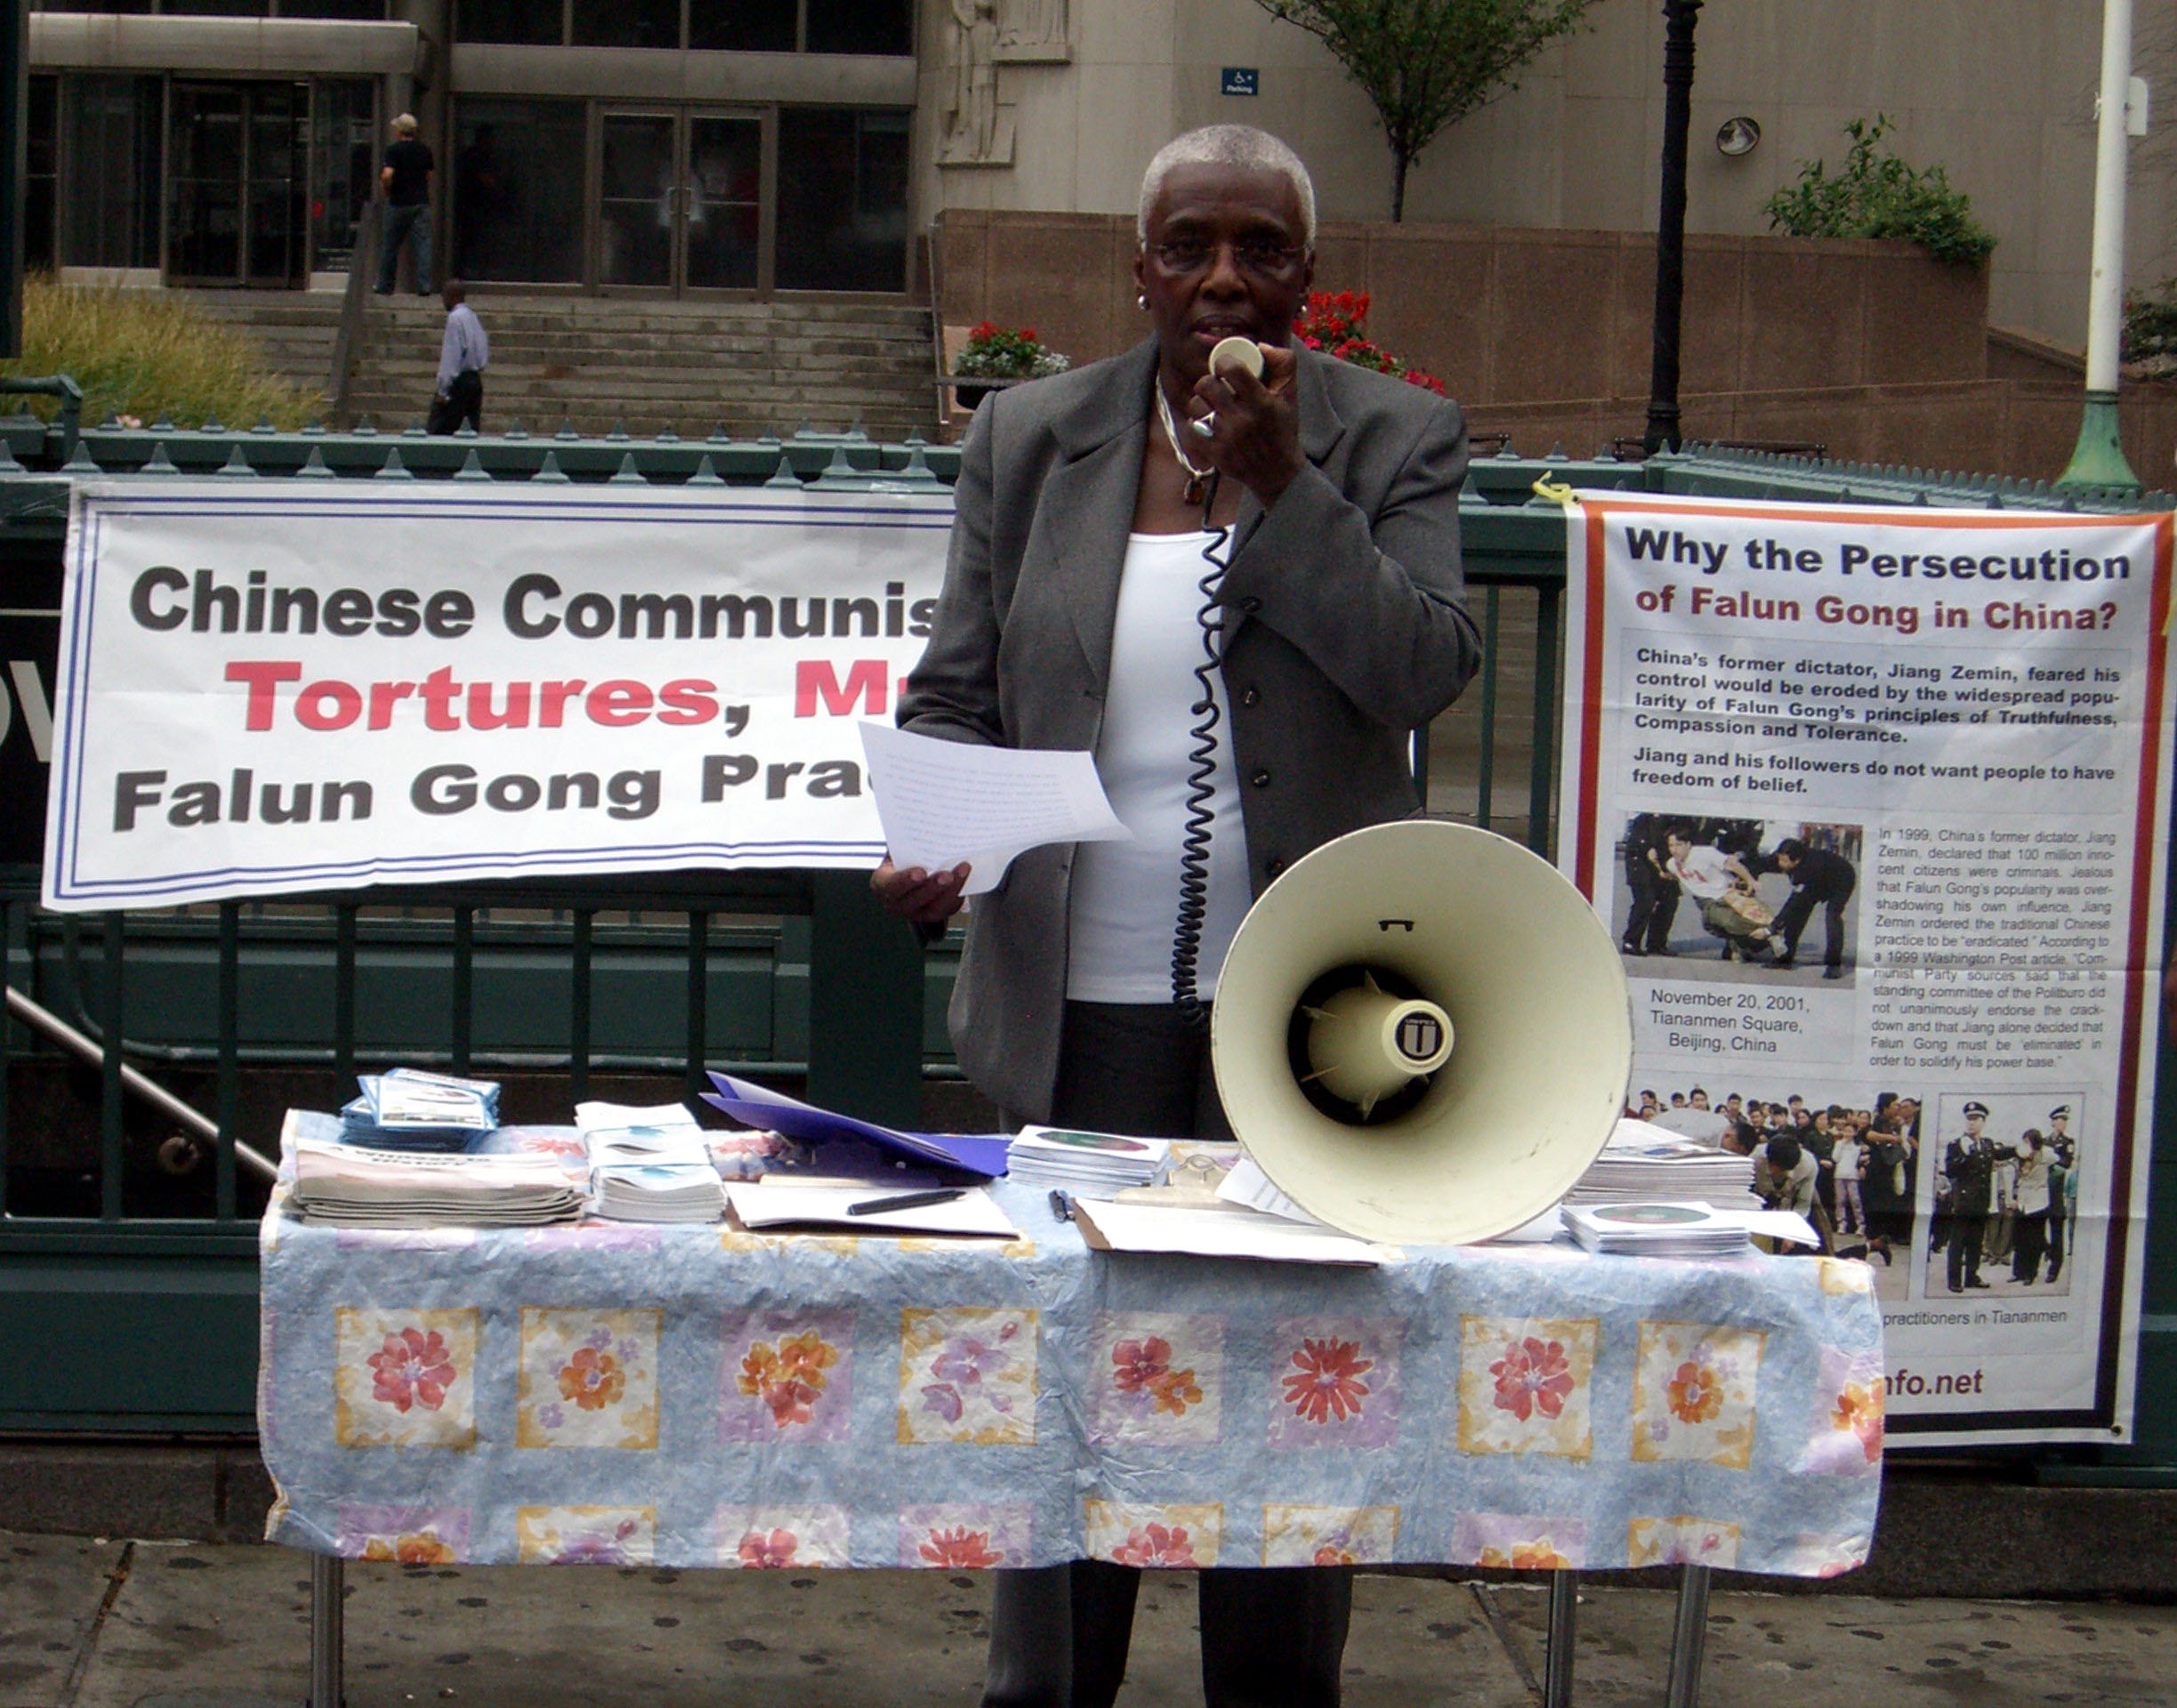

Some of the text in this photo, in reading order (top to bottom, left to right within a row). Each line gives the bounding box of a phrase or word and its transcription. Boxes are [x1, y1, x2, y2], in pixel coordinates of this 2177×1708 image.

[1625, 527, 2131, 582] Why the Persecution
[129, 566, 939, 640] Chinese Communis
[1636, 584, 2118, 634] of Falun Gong in China?
[1637, 648, 2120, 682] China's former dictator, Jiang Zemin, feared his
[224, 660, 907, 737] Tortures, M
[1636, 673, 2120, 706] control would be eroded by the widespread popu-
[1635, 692, 2117, 727] larity of Falun Gong's principles of Truthfulness,
[1634, 713, 1907, 744] Compassion and Tolerance.
[1633, 747, 2114, 782] Jiang and his followers do not want people to have
[1633, 769, 1807, 793] freedom of belief.
[113, 753, 873, 833] Falun Gong Pra
[1879, 829, 1891, 840] In
[1939, 830, 1985, 842] China's
[1990, 831, 2029, 842] former
[2086, 833, 2116, 845] Jiang
[1928, 847, 1982, 859] declared
[1988, 848, 2011, 860] that
[2019, 849, 2039, 860] 100
[2044, 850, 2082, 860] million
[2087, 850, 2115, 860] inno-
[1878, 865, 2113, 878] cent citizens were criminals. Jealous
[1877, 881, 2112, 898] that Falun Gong's popularity was over-
[1876, 899, 2111, 914] shadowing his own influence. Jiang
[1875, 915, 2110, 930] Zemin ordered the traditional Chinese
[1875, 934, 1923, 949] practice
[1927, 936, 1939, 946] to
[1942, 935, 1958, 947] be
[2039, 936, 2095, 949] According
[2099, 937, 2108, 947] to
[1874, 954, 1882, 963] a
[1888, 952, 1918, 963] 1999
[1923, 953, 1996, 967] Washington
[2000, 953, 2027, 964] Post
[1873, 969, 2107, 982] munist Party sources said that the
[1651, 989, 1810, 1013] November 20, 2001,
[1873, 987, 2106, 999] standing committee of the Politburo did
[1873, 1003, 2104, 1018] not unanimously endorse the crack-
[1651, 1011, 1803, 1034] Tiananmen Square,
[1872, 1020, 2103, 1035] down and that Jiang alone decided that
[1669, 1033, 1777, 1052] Beijing, China
[1871, 1037, 1904, 1049] Falun
[1914, 1038, 1947, 1052] Gong
[1957, 1040, 1987, 1050] must
[1996, 1039, 2012, 1050] be
[2092, 1039, 2101, 1049] in
[1870, 1055, 1900, 1067] order
[1904, 1057, 1916, 1067] to
[1920, 1056, 1962, 1070] solidify
[1966, 1057, 1983, 1068] his
[1987, 1059, 2023, 1070] power
[1883, 1309, 2068, 1327] practitioners in Tiananmen
